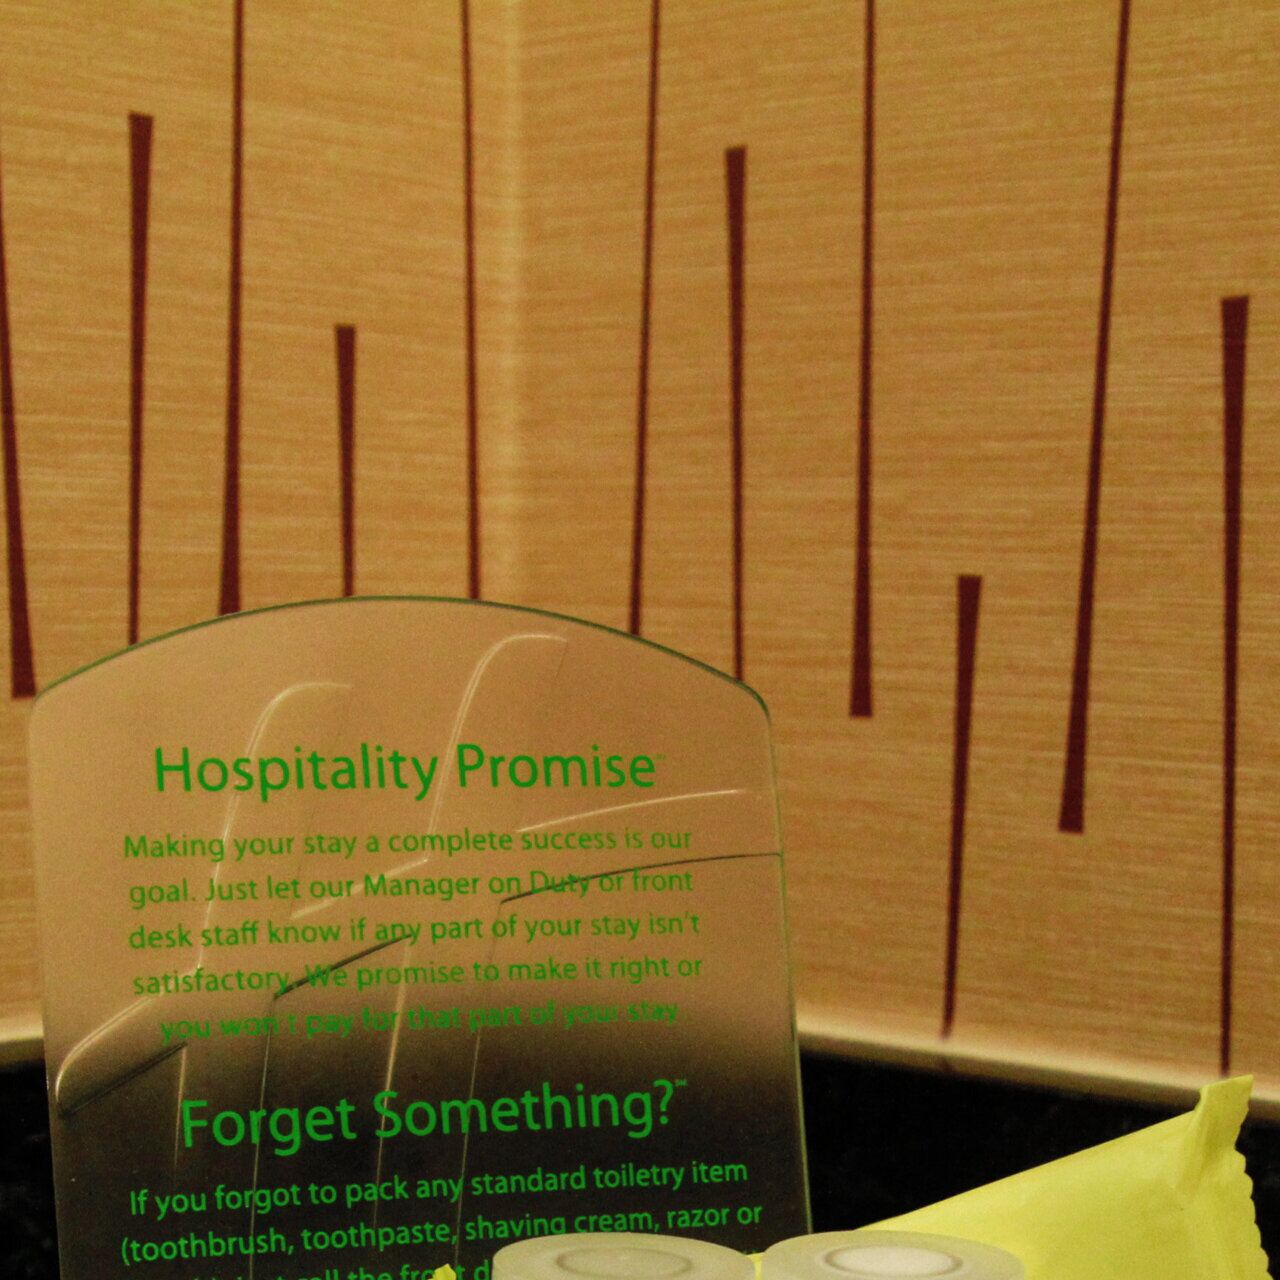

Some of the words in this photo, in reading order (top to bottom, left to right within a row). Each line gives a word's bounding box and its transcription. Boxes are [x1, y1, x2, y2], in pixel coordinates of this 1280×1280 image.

[155, 742, 438, 803] Hospitality
[457, 743, 656, 788] Promise
[123, 833, 225, 862] Making
[233, 836, 295, 862] your
[304, 831, 358, 859] stay
[366, 836, 381, 853] a
[388, 827, 514, 857] complete
[521, 831, 617, 851] success
[624, 828, 644, 850] is
[650, 830, 693, 850] our
[129, 878, 197, 910] goal.
[205, 877, 259, 902] Just
[267, 876, 301, 900] let
[309, 879, 354, 899] our
[363, 873, 480, 901] Manager
[488, 875, 522, 895] on
[530, 869, 591, 898] Duty
[598, 872, 624, 894] or
[631, 869, 694, 893] front
[128, 924, 193, 950] desk
[201, 920, 260, 947] staff
[268, 920, 341, 945] know
[350, 917, 367, 942] if
[374, 922, 421, 946] any
[431, 918, 484, 945] part
[491, 913, 518, 938] of
[525, 918, 582, 943] your
[591, 914, 641, 941] stay
[648, 912, 700, 935] isn't
[304, 963, 349, 989] We
[357, 961, 465, 991] promise
[473, 962, 500, 982] to
[508, 957, 578, 982] make
[585, 956, 601, 979] it
[609, 955, 671, 985] right
[677, 958, 702, 977] or
[160, 1018, 211, 1046] you
[219, 1013, 297, 1038] wont
[305, 1011, 354, 1038] pay
[406, 1004, 462, 1030] that
[469, 1003, 522, 1035] part
[529, 1000, 556, 1025] of
[560, 1003, 619, 1030] your
[181, 1097, 358, 1157] Forget
[373, 1079, 674, 1139] Something?
[130, 1188, 148, 1216] If
[155, 1192, 208, 1221] you
[215, 1184, 301, 1215] forgot
[308, 1183, 338, 1205] to
[345, 1174, 409, 1209] pack
[416, 1177, 464, 1202] any
[471, 1166, 586, 1196] standard
[593, 1162, 685, 1191] toiletry
[691, 1160, 749, 1184] item
[121, 1226, 295, 1267] (toothbrush,
[301, 1220, 458, 1252] toothpaste,
[465, 1213, 566, 1241] shaving
[574, 1209, 660, 1234] cream,
[667, 1206, 731, 1229] razor
[737, 1205, 763, 1225] or
